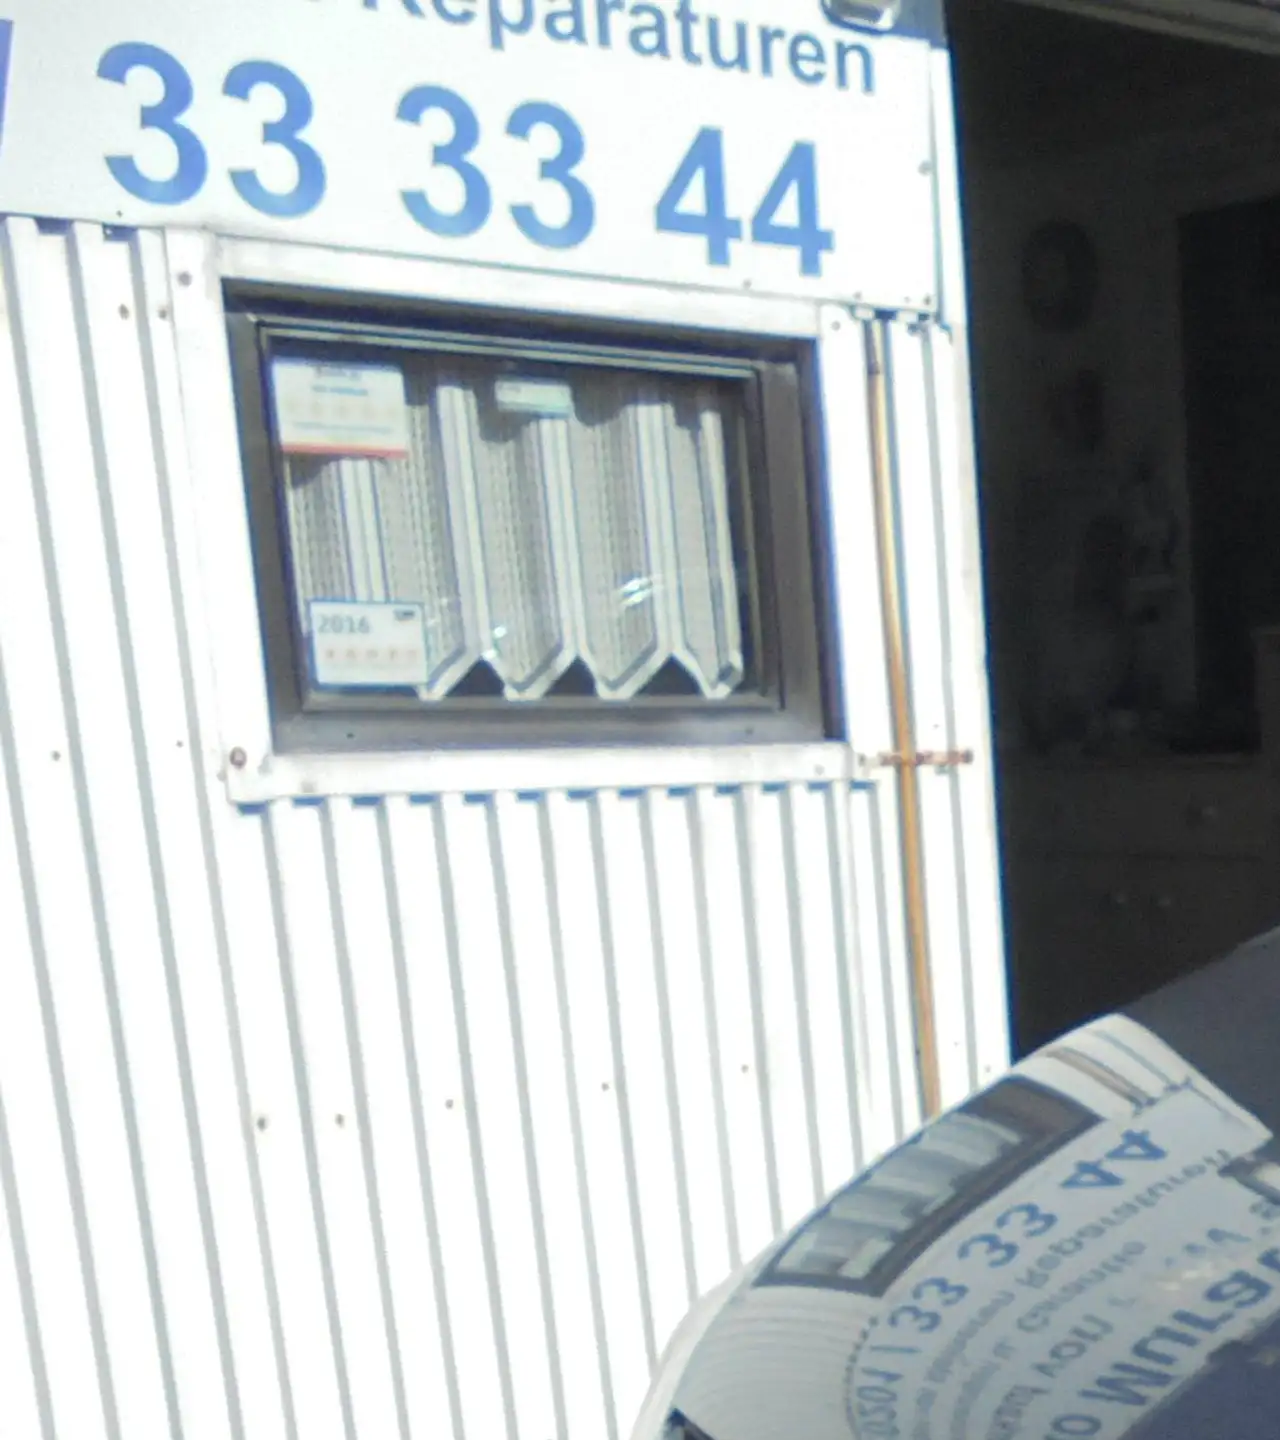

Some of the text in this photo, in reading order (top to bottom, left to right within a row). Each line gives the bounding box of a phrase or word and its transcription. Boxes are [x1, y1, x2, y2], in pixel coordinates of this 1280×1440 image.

[362, 0, 877, 95] eparaturen
[96, 40, 835, 277] 33 33 44
[318, 613, 370, 635] 2016
